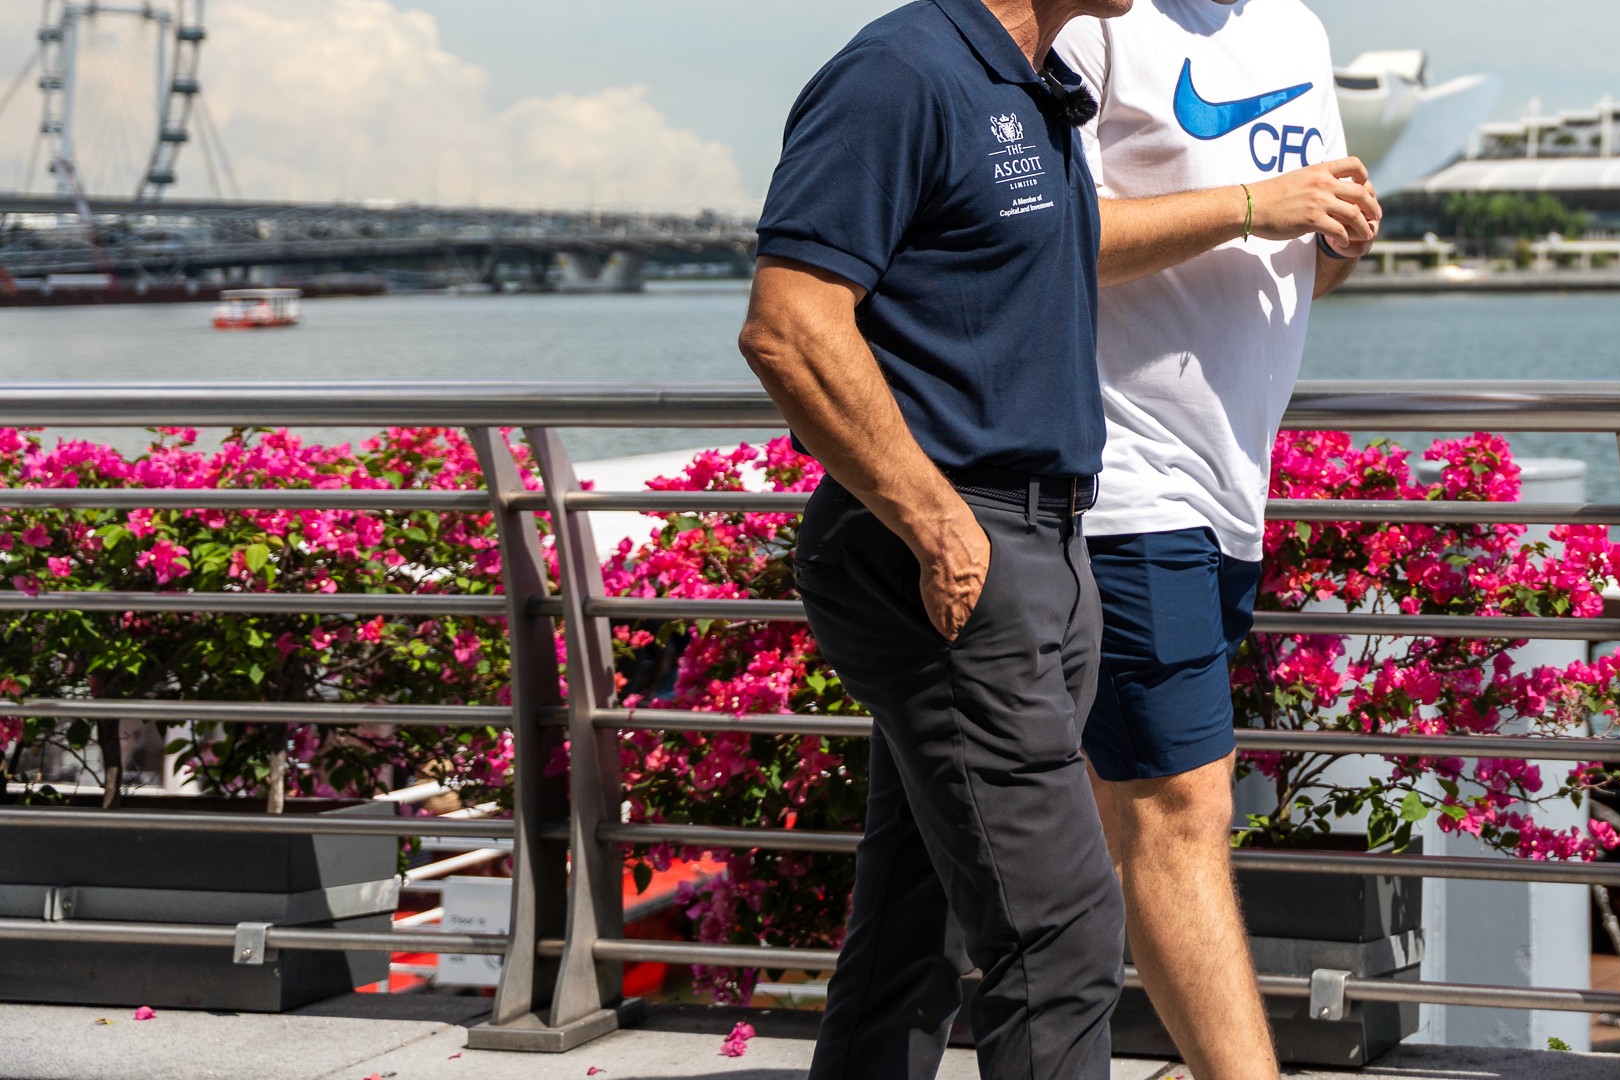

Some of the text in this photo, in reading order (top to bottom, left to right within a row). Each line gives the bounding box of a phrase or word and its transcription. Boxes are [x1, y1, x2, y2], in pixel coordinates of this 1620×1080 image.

[1005, 144, 1024, 156] THE
[994, 156, 1042, 178] ASCOTT
[1010, 179, 1038, 190] LIMITED
[1018, 196, 1037, 205] Member
[1030, 201, 1054, 211] Investment
